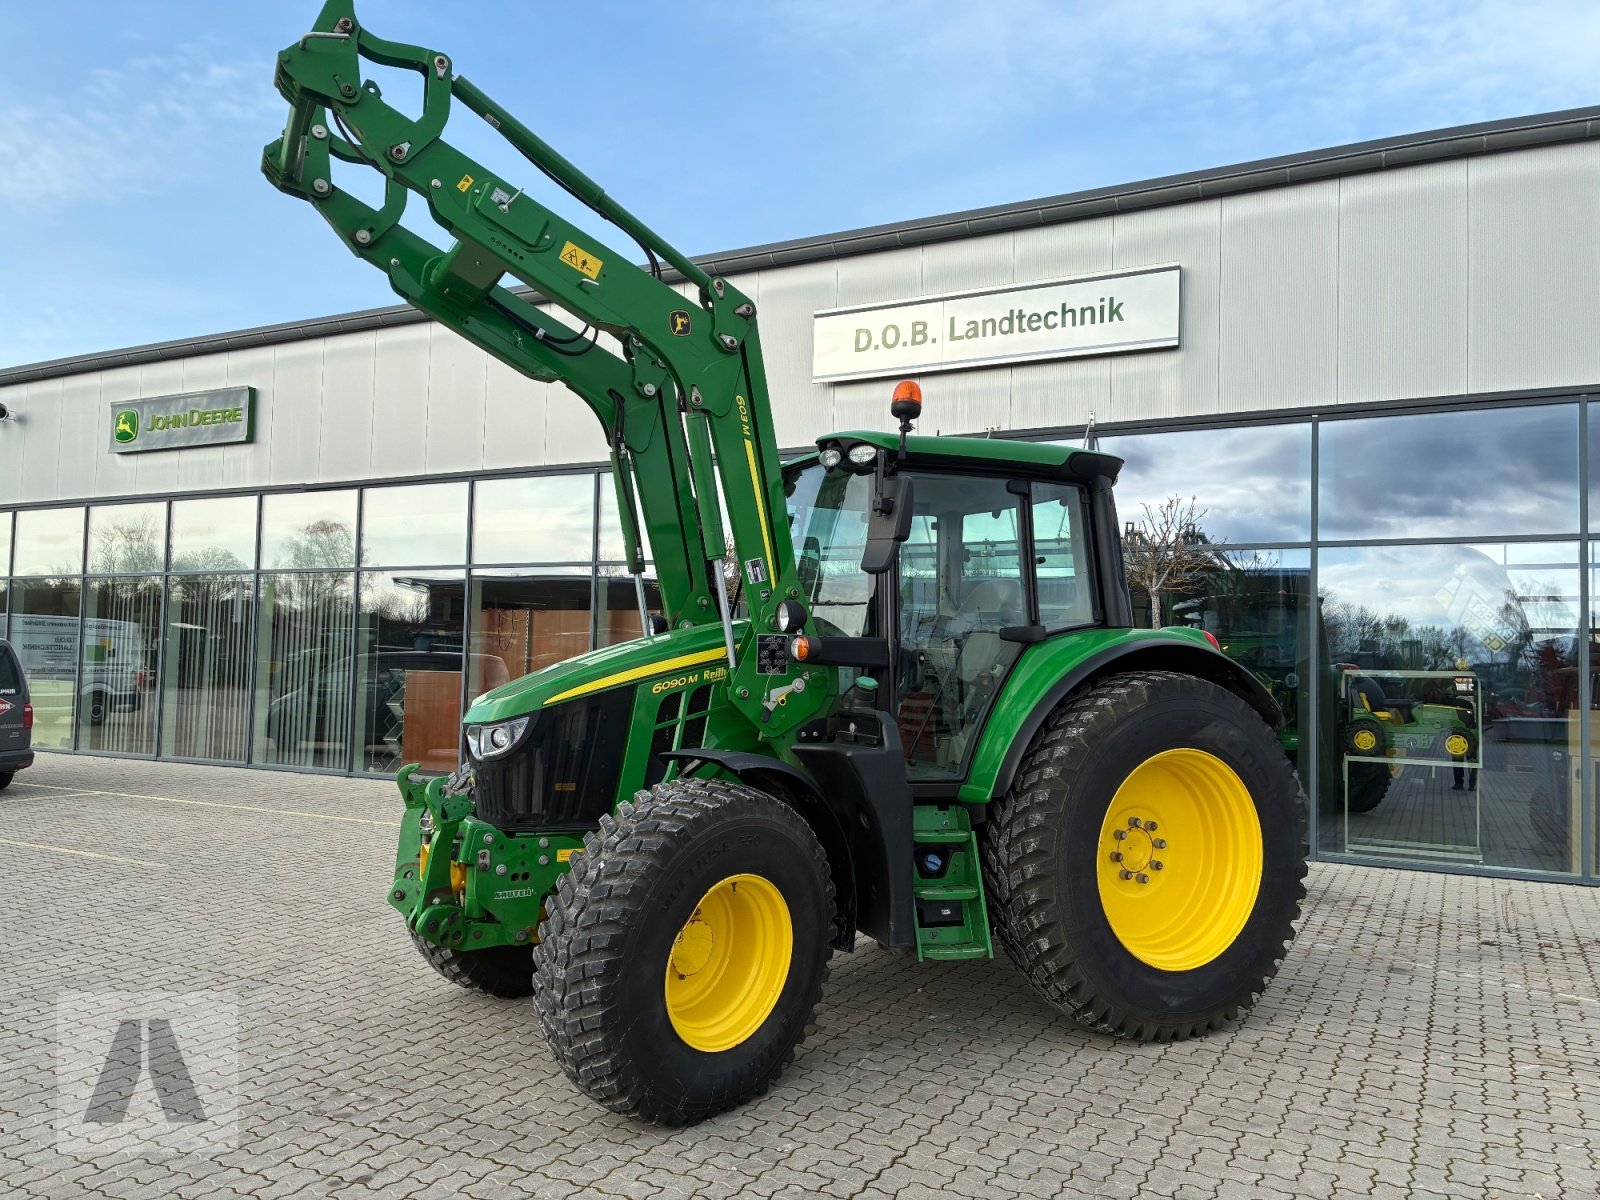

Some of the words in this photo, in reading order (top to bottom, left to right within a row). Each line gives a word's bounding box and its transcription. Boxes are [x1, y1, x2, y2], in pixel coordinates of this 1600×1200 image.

[854, 320, 937, 352] D.O.B.
[949, 296, 1125, 342] Landtechnik
[146, 413, 188, 432] JOHN
[189, 406, 243, 427] DEERE
[735, 394, 748, 423] 603
[742, 423, 751, 436] M
[652, 677, 687, 694] 6090
[688, 673, 699, 684] M
